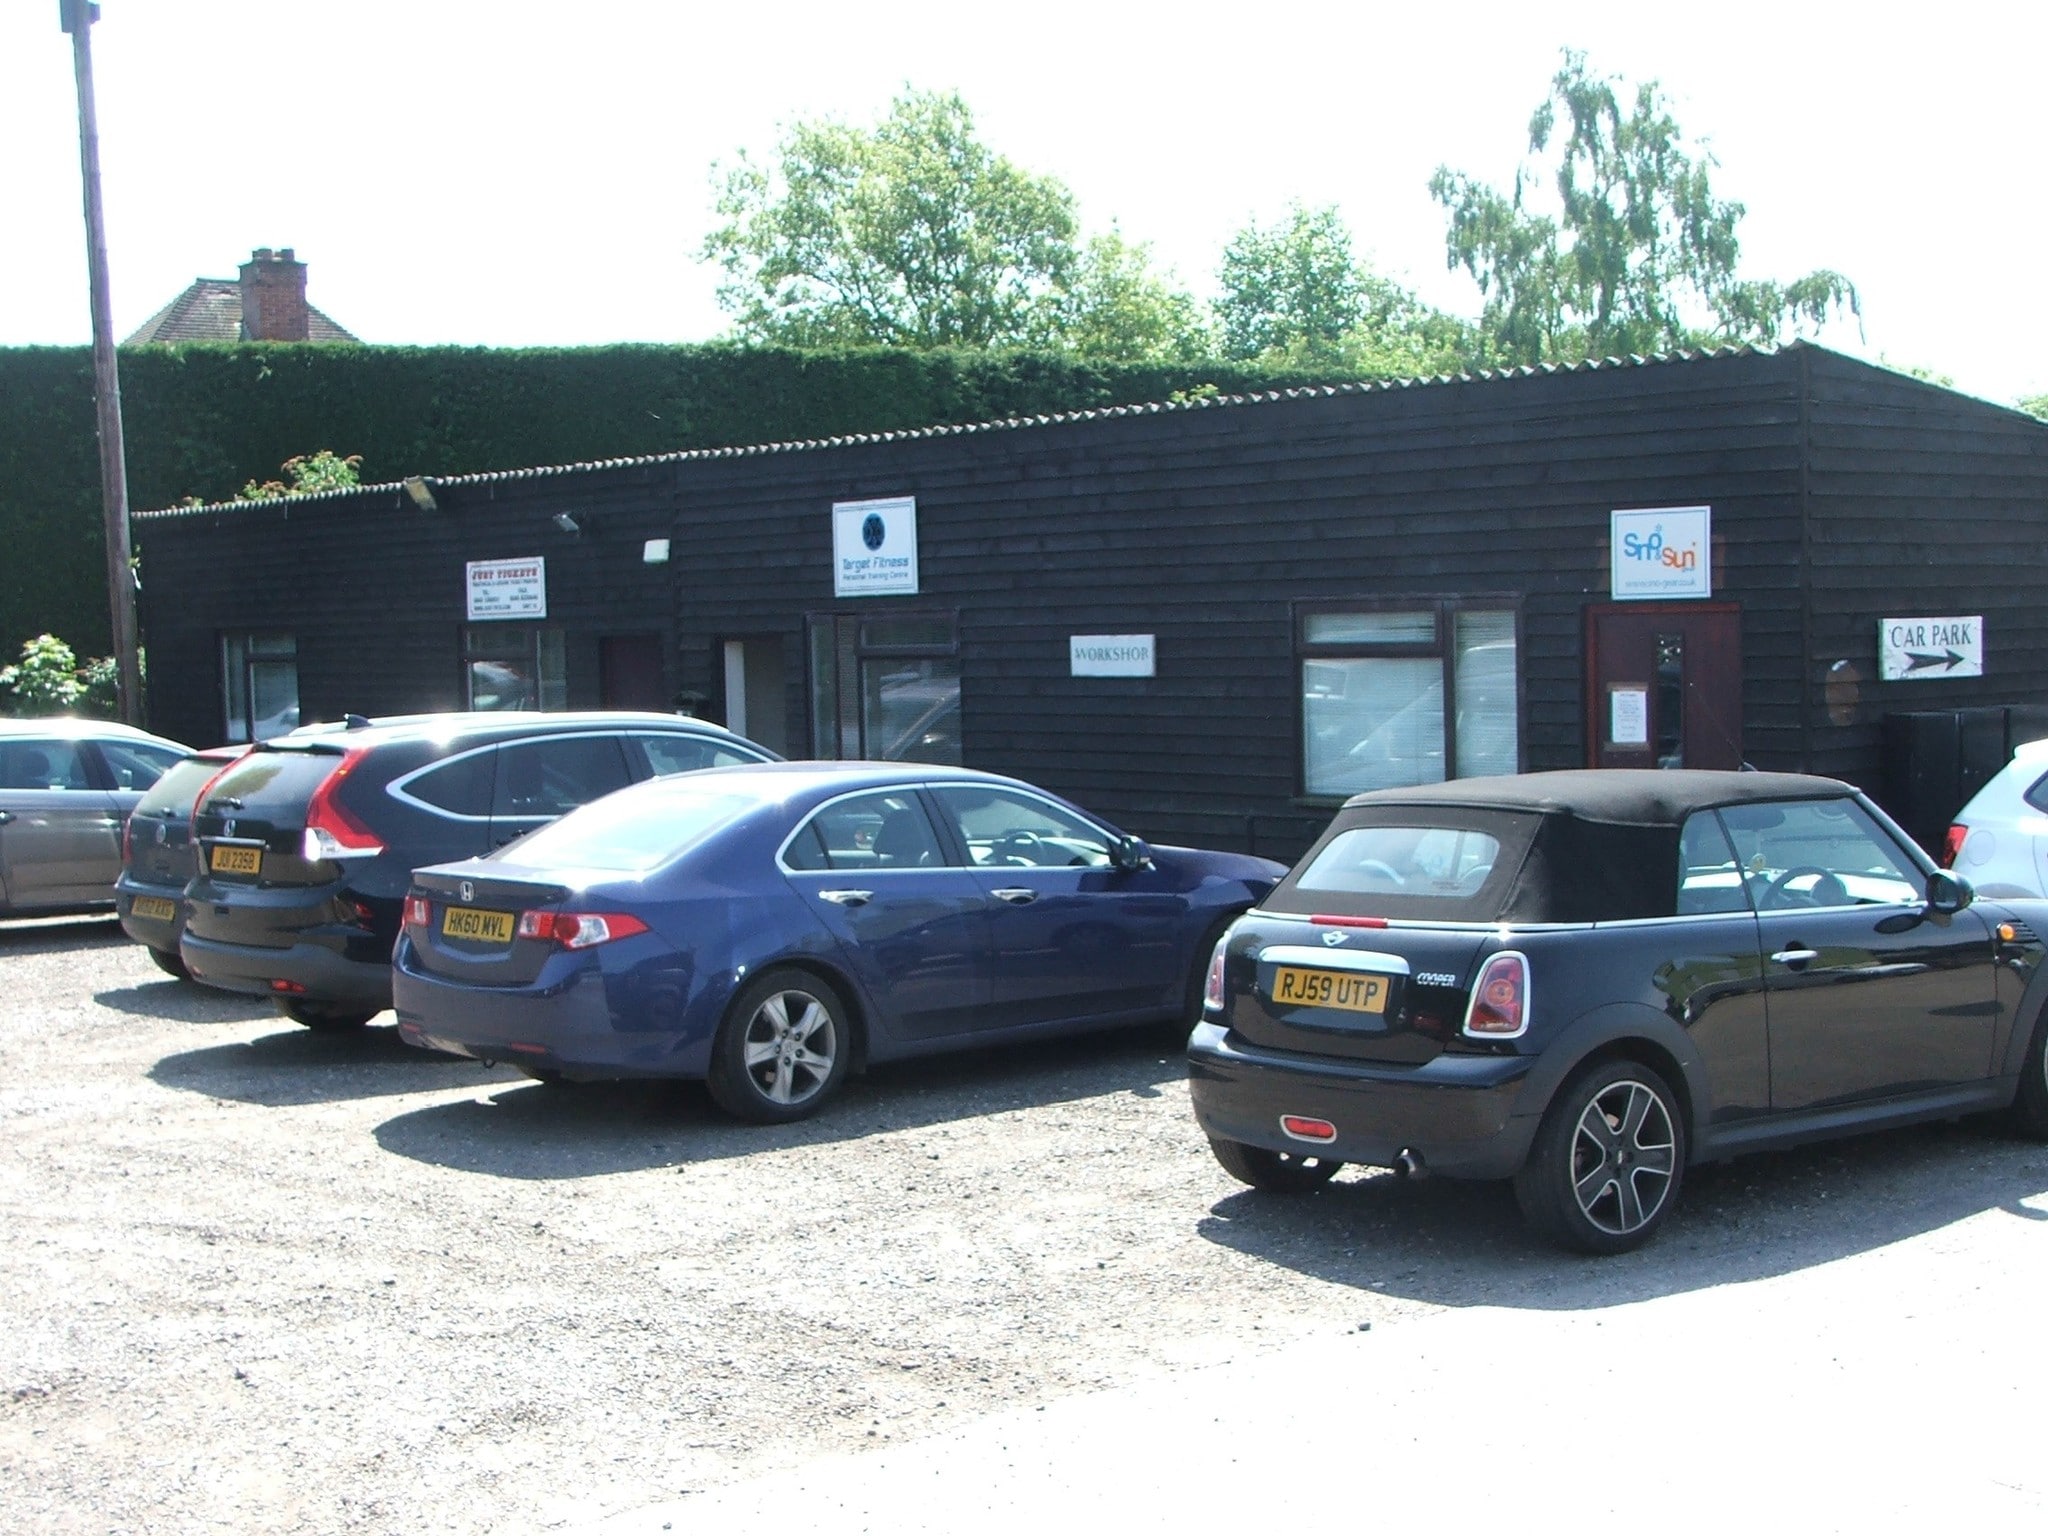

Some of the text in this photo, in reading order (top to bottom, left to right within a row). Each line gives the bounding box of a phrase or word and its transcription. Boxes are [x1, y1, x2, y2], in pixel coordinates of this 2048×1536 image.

[472, 567, 539, 580] JUST TICKETS
[842, 556, 909, 574] Target Fitness
[1891, 623, 1972, 648] CAR PARK
[447, 911, 480, 934] HK60
[1280, 972, 1379, 1007] RJ59 UTP
[1416, 972, 1456, 987] COOPER
